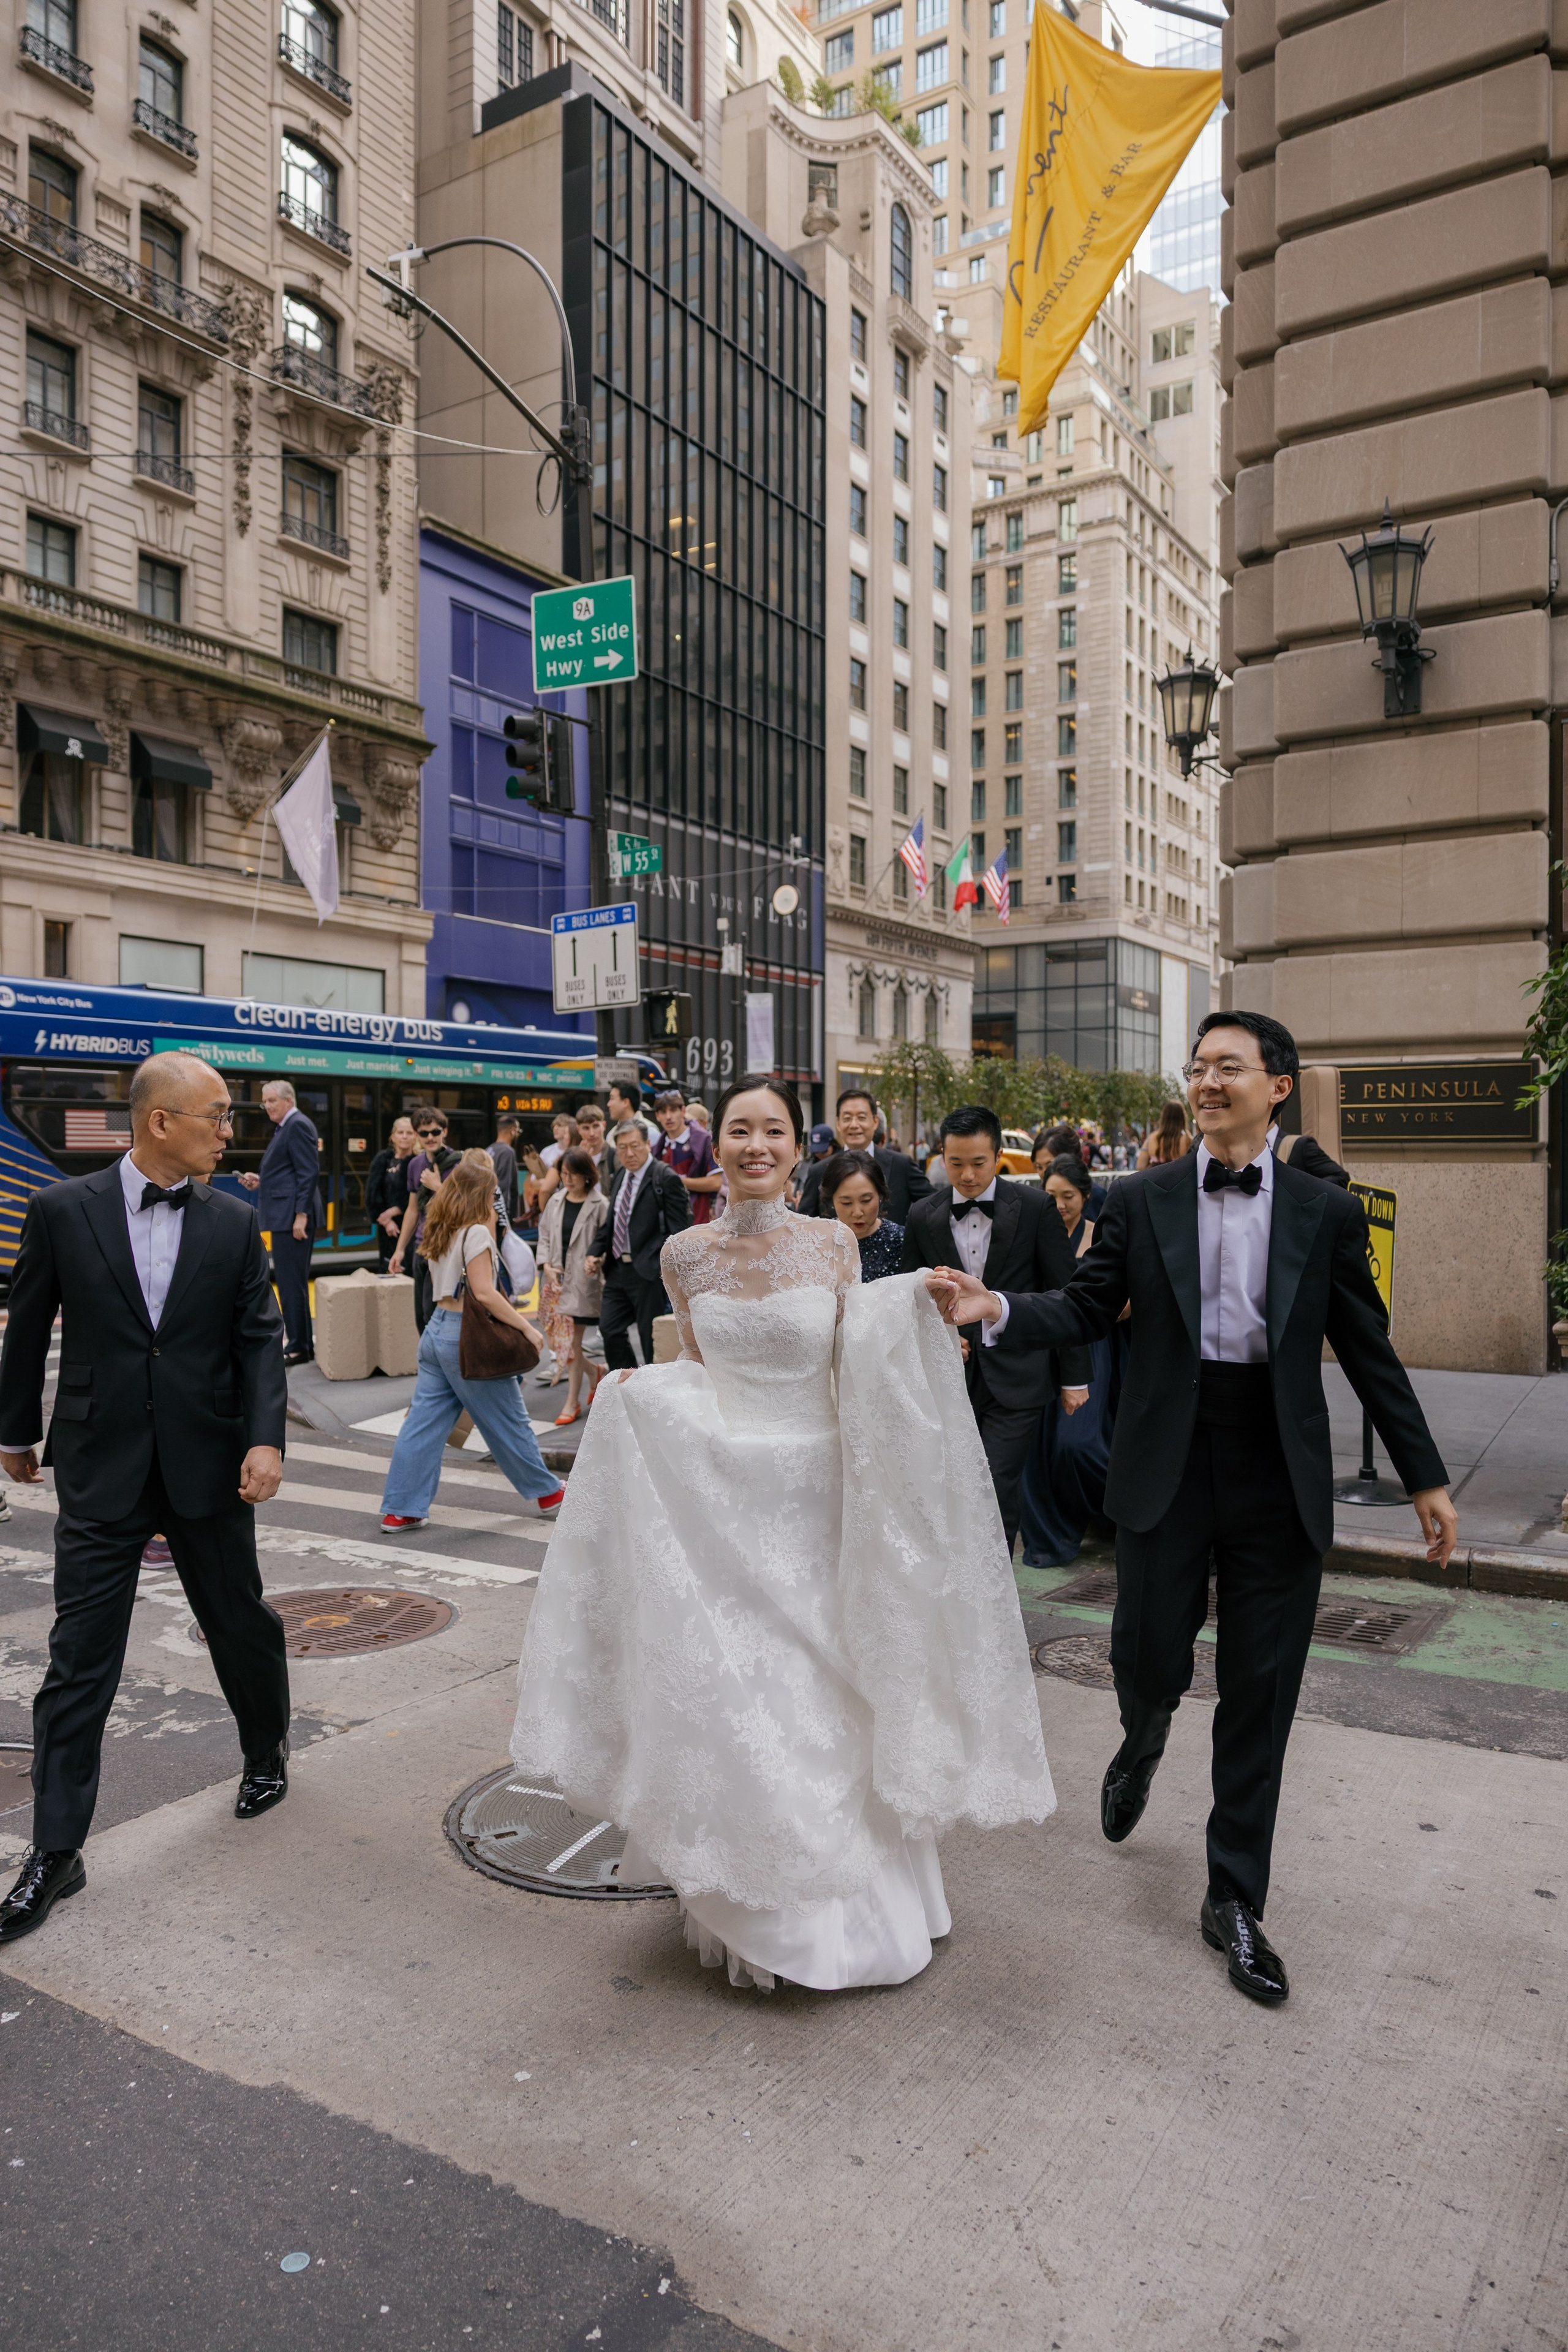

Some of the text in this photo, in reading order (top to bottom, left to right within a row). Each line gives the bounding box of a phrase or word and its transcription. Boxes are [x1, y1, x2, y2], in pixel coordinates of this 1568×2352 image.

[1023, 143, 1143, 339] RESTAURANT & BAR
[575, 601, 591, 616] 9A
[540, 622, 629, 652] West Side
[546, 659, 582, 677] Hwy
[622, 853, 631, 872] W
[635, 851, 649, 871] 55
[651, 848, 658, 860] St
[614, 872, 699, 904] LANT
[571, 910, 616, 929] BUS LANES
[565, 979, 585, 992] BUSES
[605, 974, 626, 987] BUSES
[17, 993, 37, 1003] New
[37, 995, 57, 1006] York
[57, 997, 75, 1008] City
[75, 998, 93, 1009] Bus
[567, 995, 584, 1005] ONLY
[607, 989, 625, 1001] ONLY
[234, 1001, 443, 1042] clean-energy bus
[50, 1033, 151, 1056] HYBRIDBUS
[285, 1055, 329, 1068] Just met.
[687, 1036, 733, 1076] 693
[345, 1059, 401, 1072] Just married.
[413, 1064, 431, 1074] Just
[432, 1066, 463, 1077] winging
[537, 1072, 552, 1082] NBC
[1363, 1080, 1501, 1099] PENINSULA
[1347, 1112, 1455, 1123] NEW YORK
[1372, 1197, 1393, 1221] DOWN
